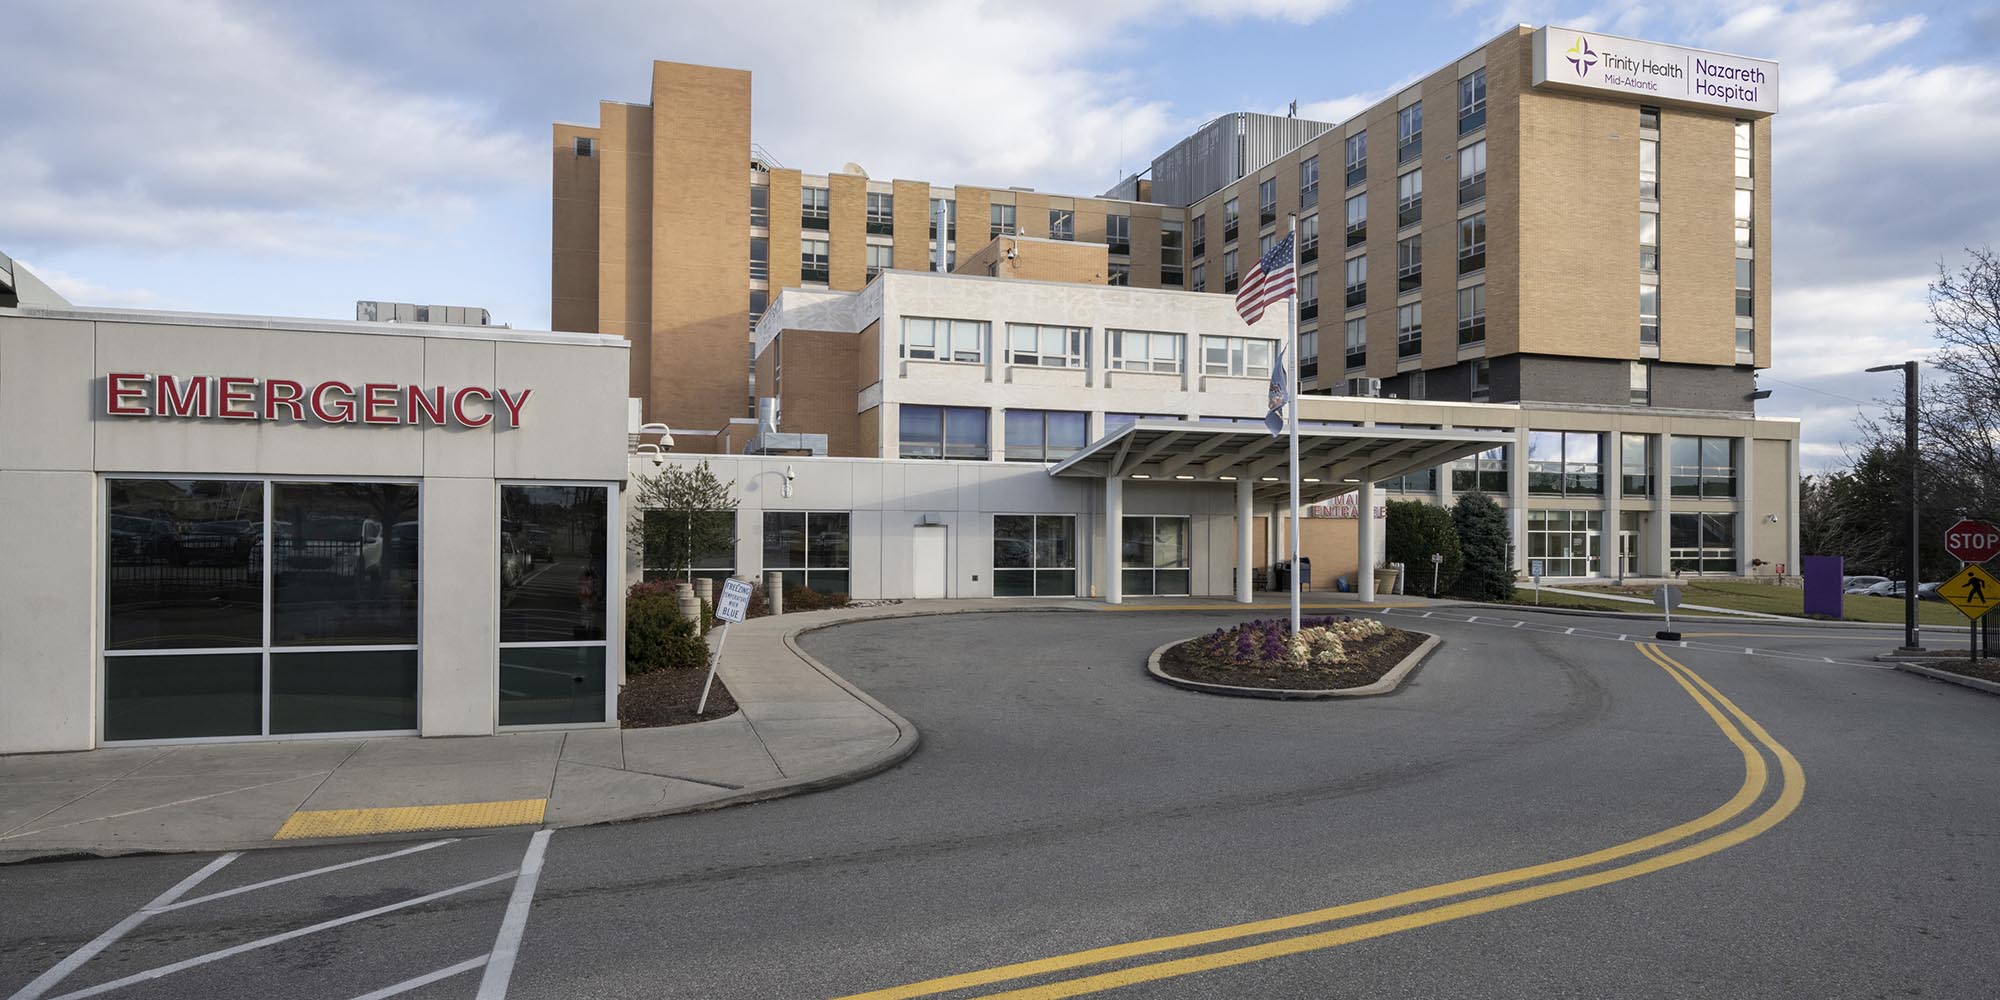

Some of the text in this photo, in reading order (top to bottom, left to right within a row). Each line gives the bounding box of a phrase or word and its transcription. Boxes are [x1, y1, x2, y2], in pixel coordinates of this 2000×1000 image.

[1602, 52, 1683, 79] Trinity Health
[1696, 58, 1765, 84] Nazareth
[1605, 74, 1657, 91] Mid-Atlantic
[1696, 79, 1758, 102] Hospital
[106, 372, 535, 428] EMERGENCY
[1334, 494, 1359, 506] MAI
[1949, 533, 1999, 549] STOP
[726, 582, 750, 595] FREEZING
[722, 607, 740, 618] BLUE
